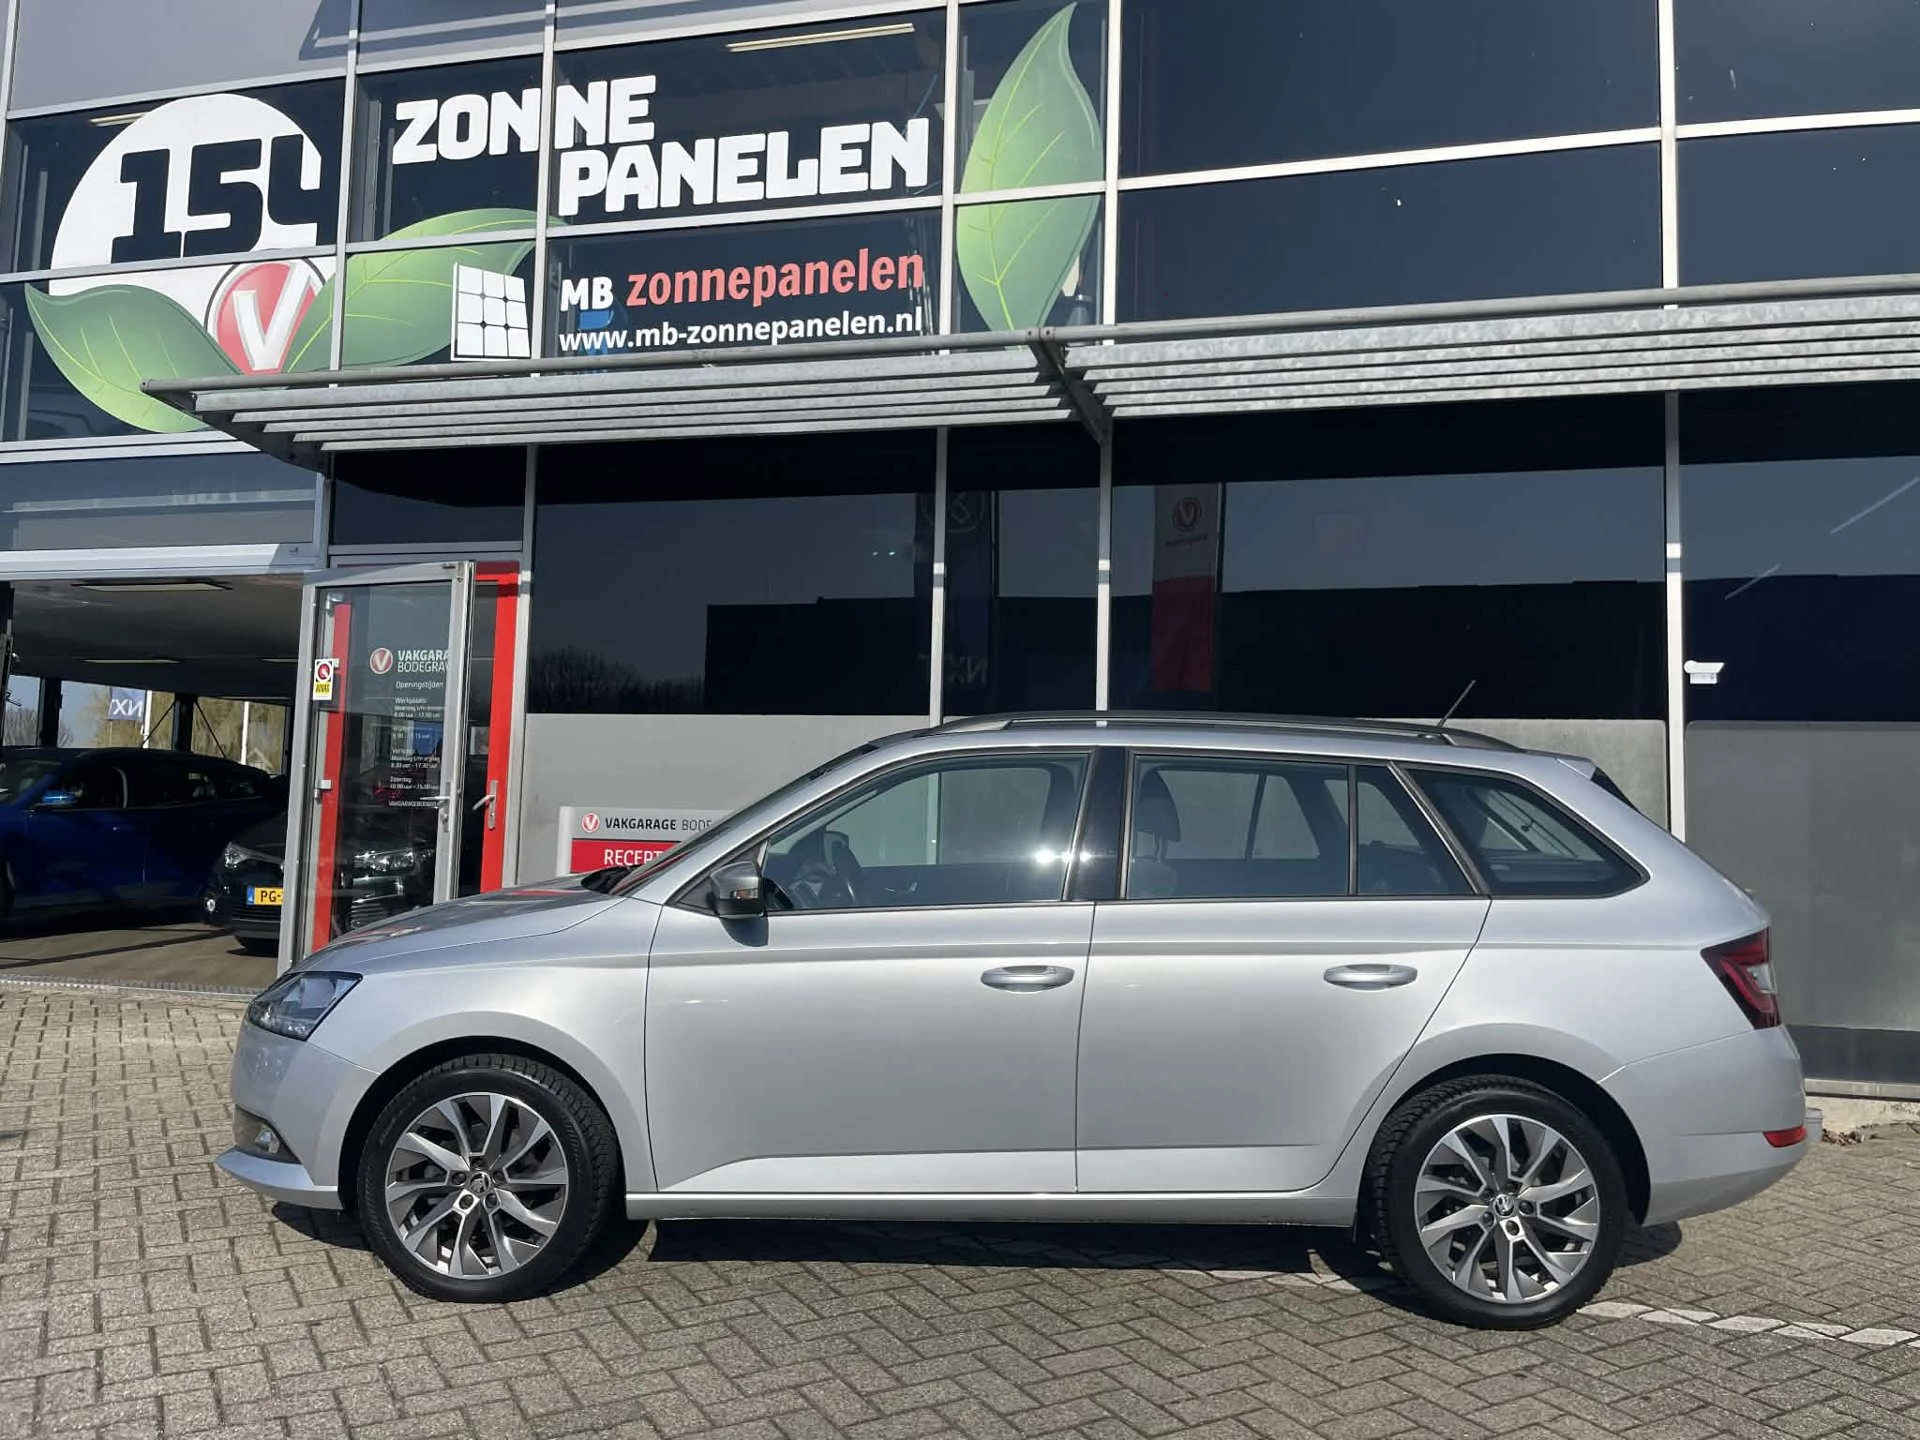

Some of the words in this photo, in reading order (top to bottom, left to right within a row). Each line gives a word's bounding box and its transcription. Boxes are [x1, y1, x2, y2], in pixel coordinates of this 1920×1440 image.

[393, 75, 657, 165] ZONNE
[110, 133, 324, 263] 154
[558, 118, 930, 216] PANELEN
[560, 276, 613, 312] MB
[626, 248, 925, 308] zonnepanelen
[559, 307, 923, 352] www.mb-zonnepanelen.nl
[605, 818, 676, 830] VAKGARAGE
